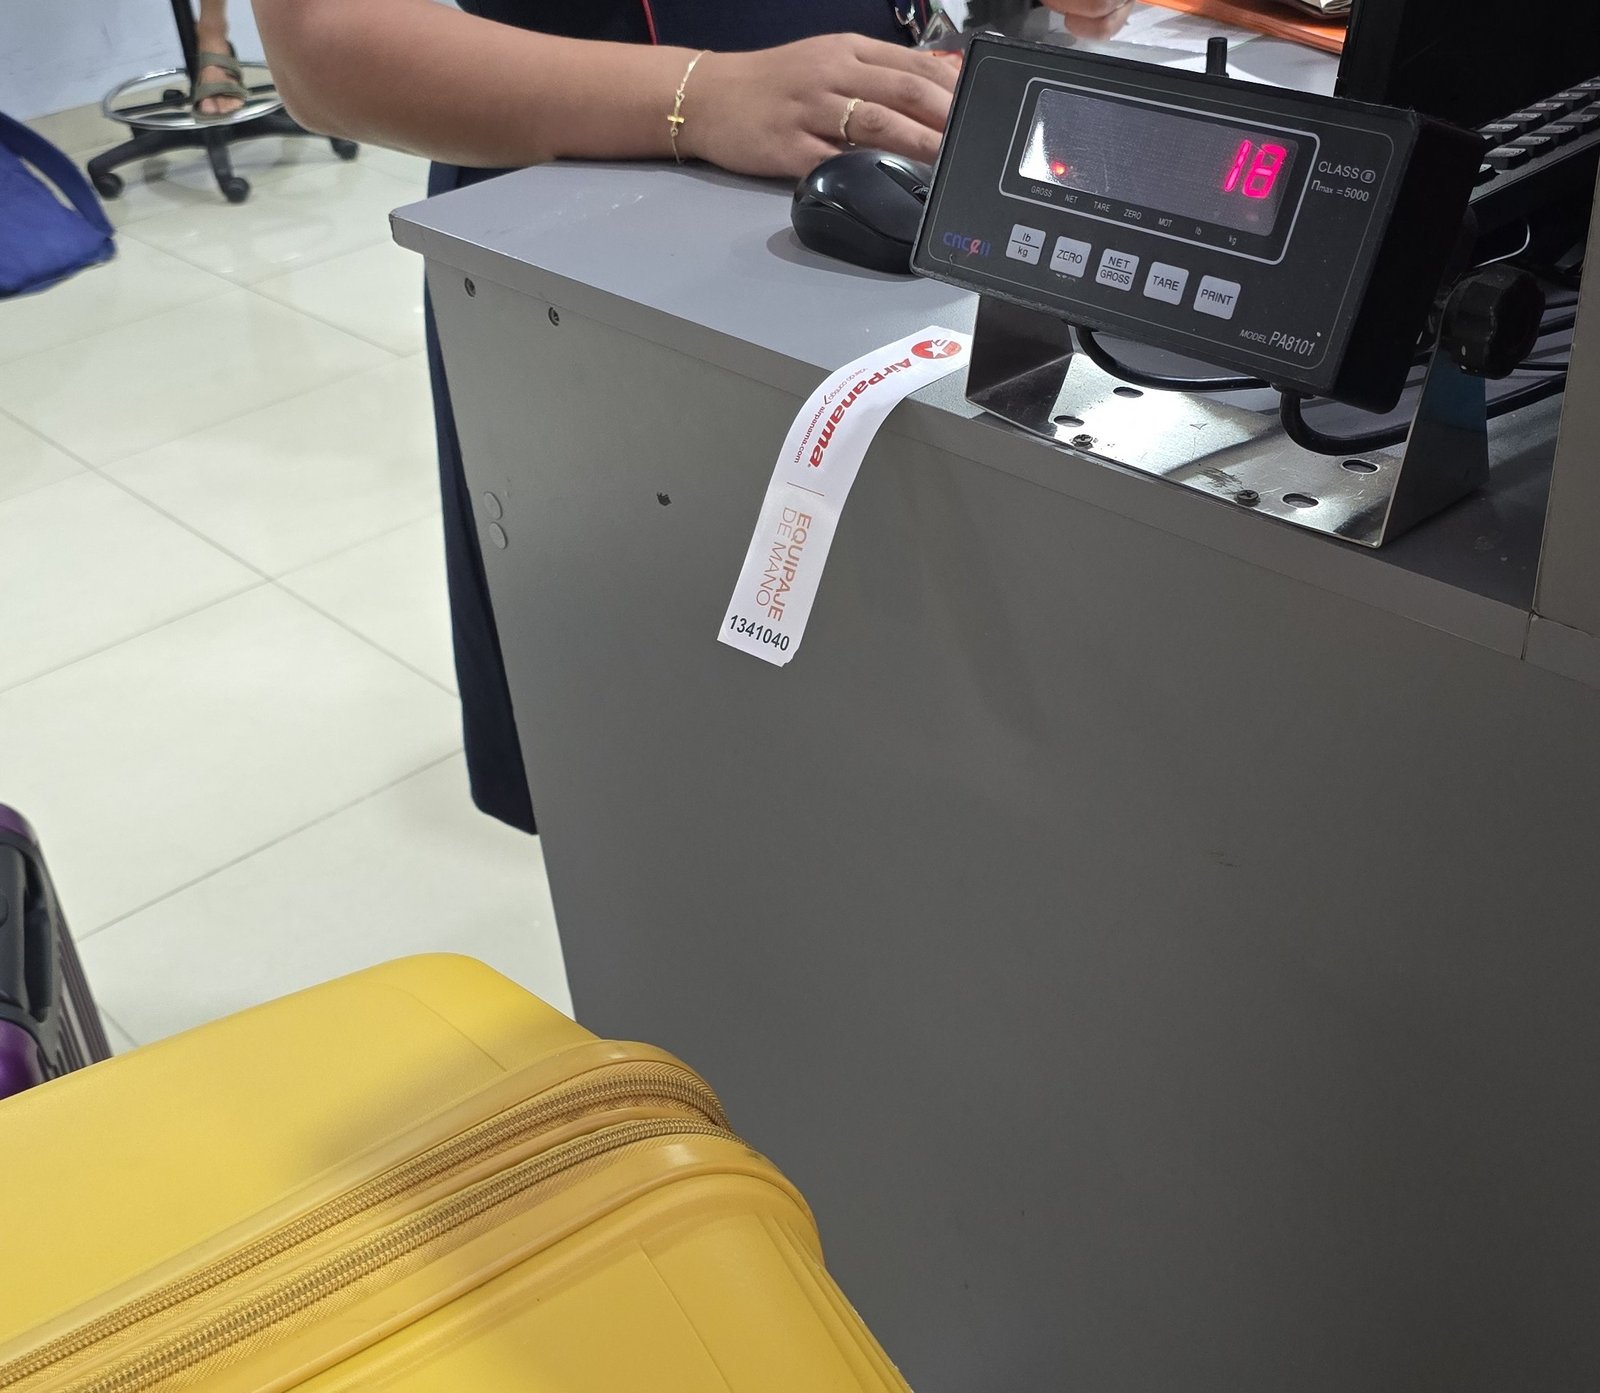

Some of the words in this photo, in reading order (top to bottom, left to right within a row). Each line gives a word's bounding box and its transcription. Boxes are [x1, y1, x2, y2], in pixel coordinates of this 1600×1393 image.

[1224, 139, 1287, 198] 18
[1318, 161, 1360, 179] CLASS
[1030, 185, 1053, 198] GROSS
[1064, 193, 1078, 205] NET
[1093, 200, 1111, 213] TARE
[1123, 208, 1142, 220] ZERO
[1022, 232, 1032, 242] lb
[1018, 246, 1029, 258] kg
[1056, 249, 1083, 264] ZERO
[1108, 256, 1131, 269] NET
[1100, 269, 1130, 285] GROSS
[1153, 275, 1180, 292] TARE
[1200, 288, 1233, 306] PRINT
[1239, 329, 1267, 344] MODEL
[1268, 331, 1316, 356] PA8101
[794, 405, 826, 464] airpanama.com
[776, 507, 798, 539] DE
[756, 541, 787, 606] MANO
[767, 512, 813, 622] EQUIPAJE
[730, 614, 790, 651] 1341040
